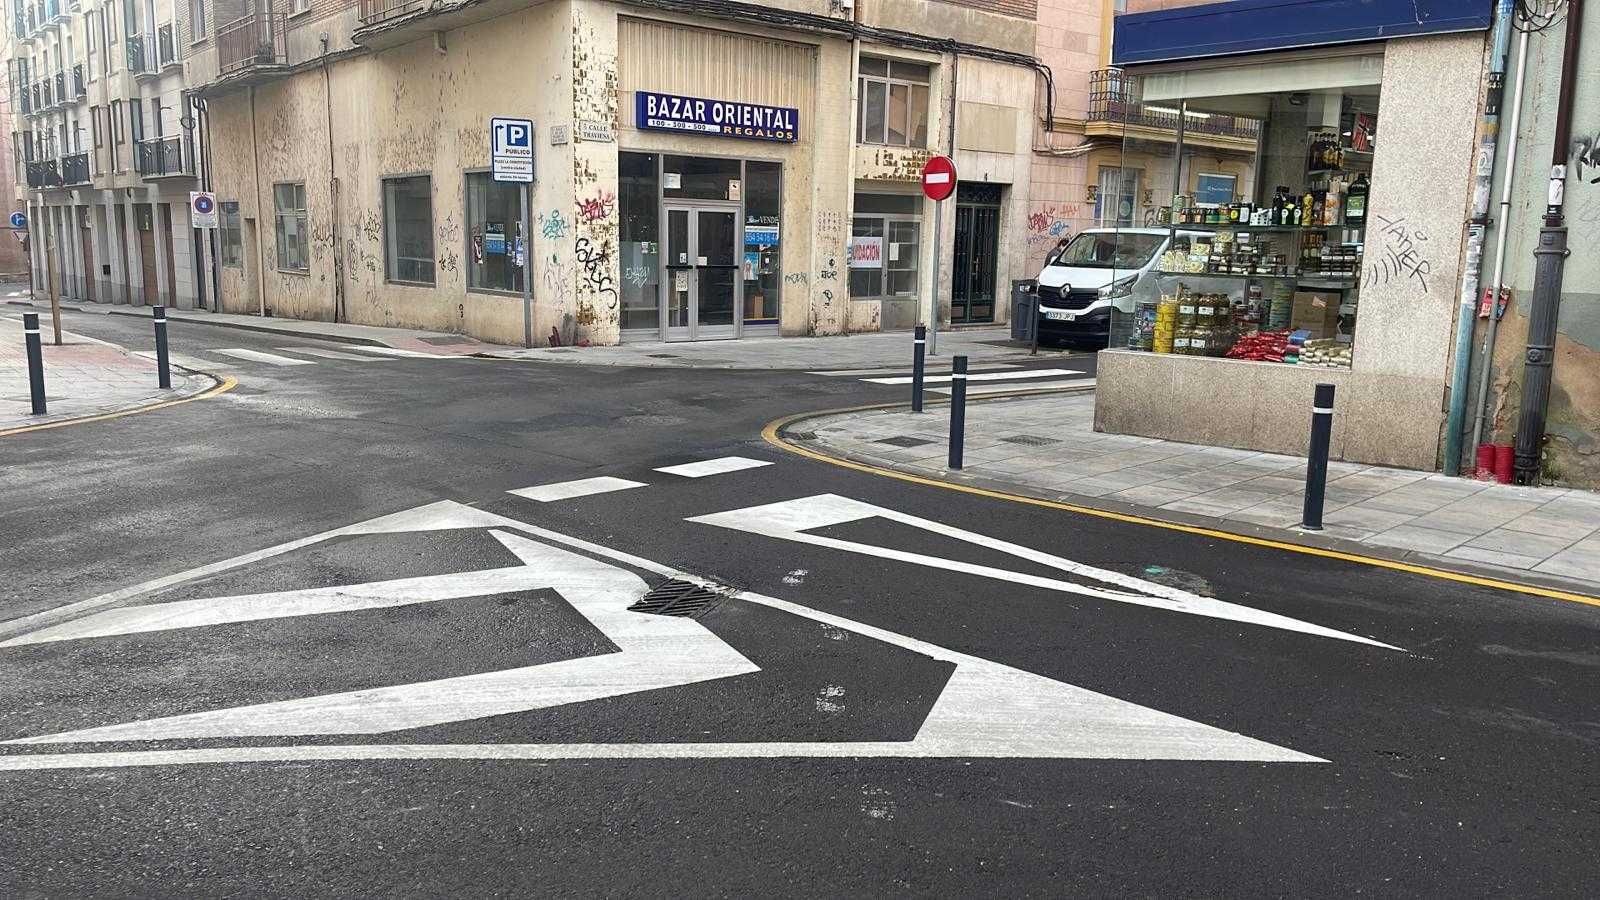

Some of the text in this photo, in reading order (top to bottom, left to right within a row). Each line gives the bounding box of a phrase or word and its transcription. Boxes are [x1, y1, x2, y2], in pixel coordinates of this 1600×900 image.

[647, 95, 793, 130] BAZAR ORIENTAL
[511, 126, 524, 145] P
[589, 124, 608, 132] CALLE
[724, 126, 793, 139] REGALOS
